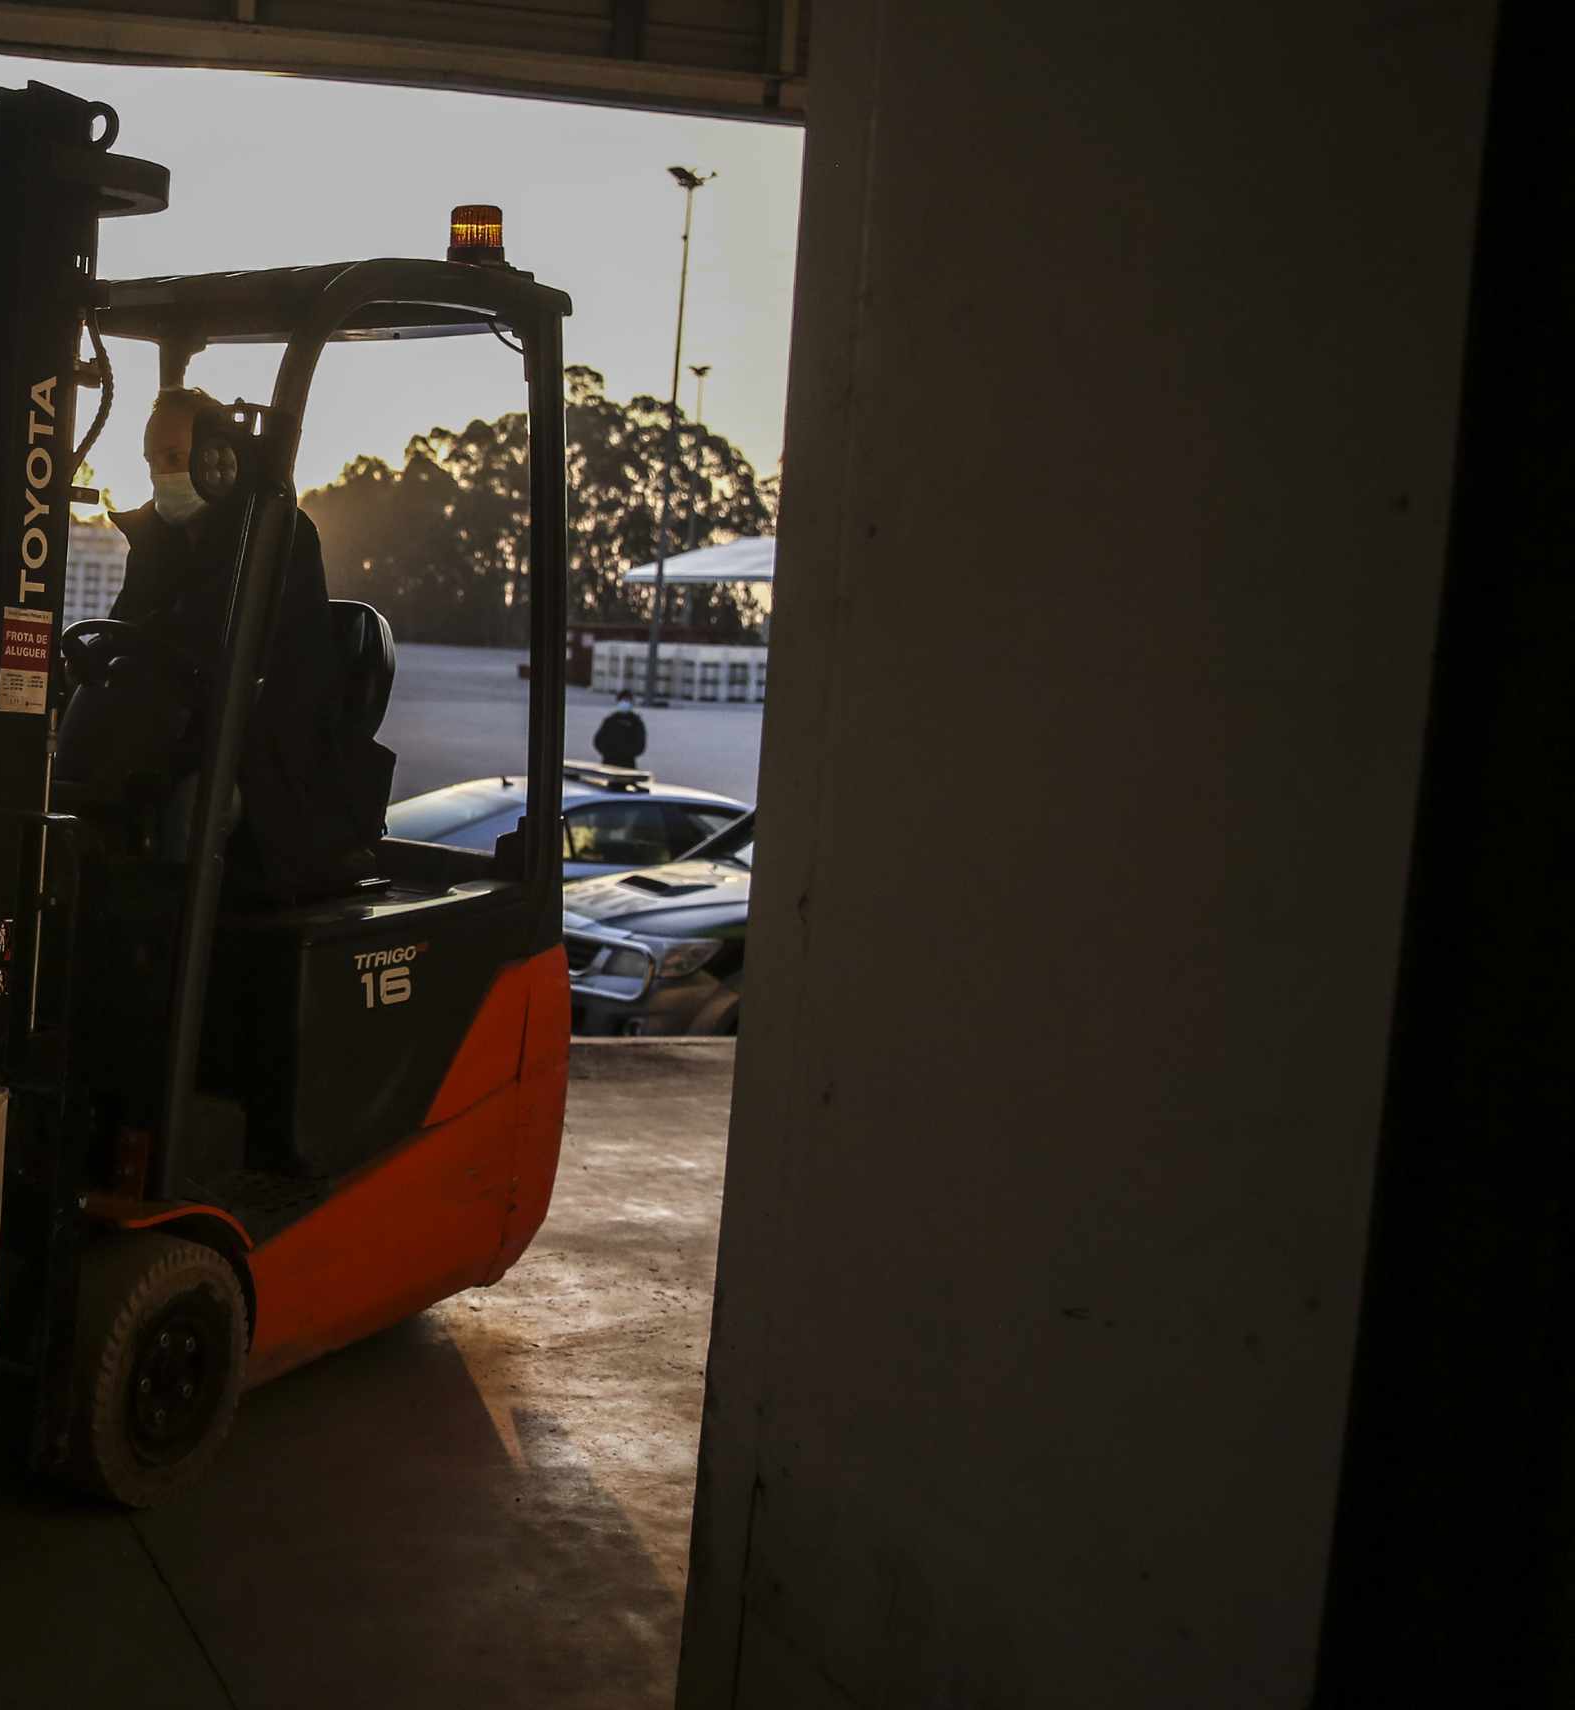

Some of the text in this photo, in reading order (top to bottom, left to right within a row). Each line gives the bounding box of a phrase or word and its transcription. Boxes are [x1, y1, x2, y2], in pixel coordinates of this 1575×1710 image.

[18, 375, 58, 603] TOYOTA
[4, 645, 46, 659] ALUGUER
[5, 630, 48, 645] FROTA DE
[360, 966, 412, 1009] 16
